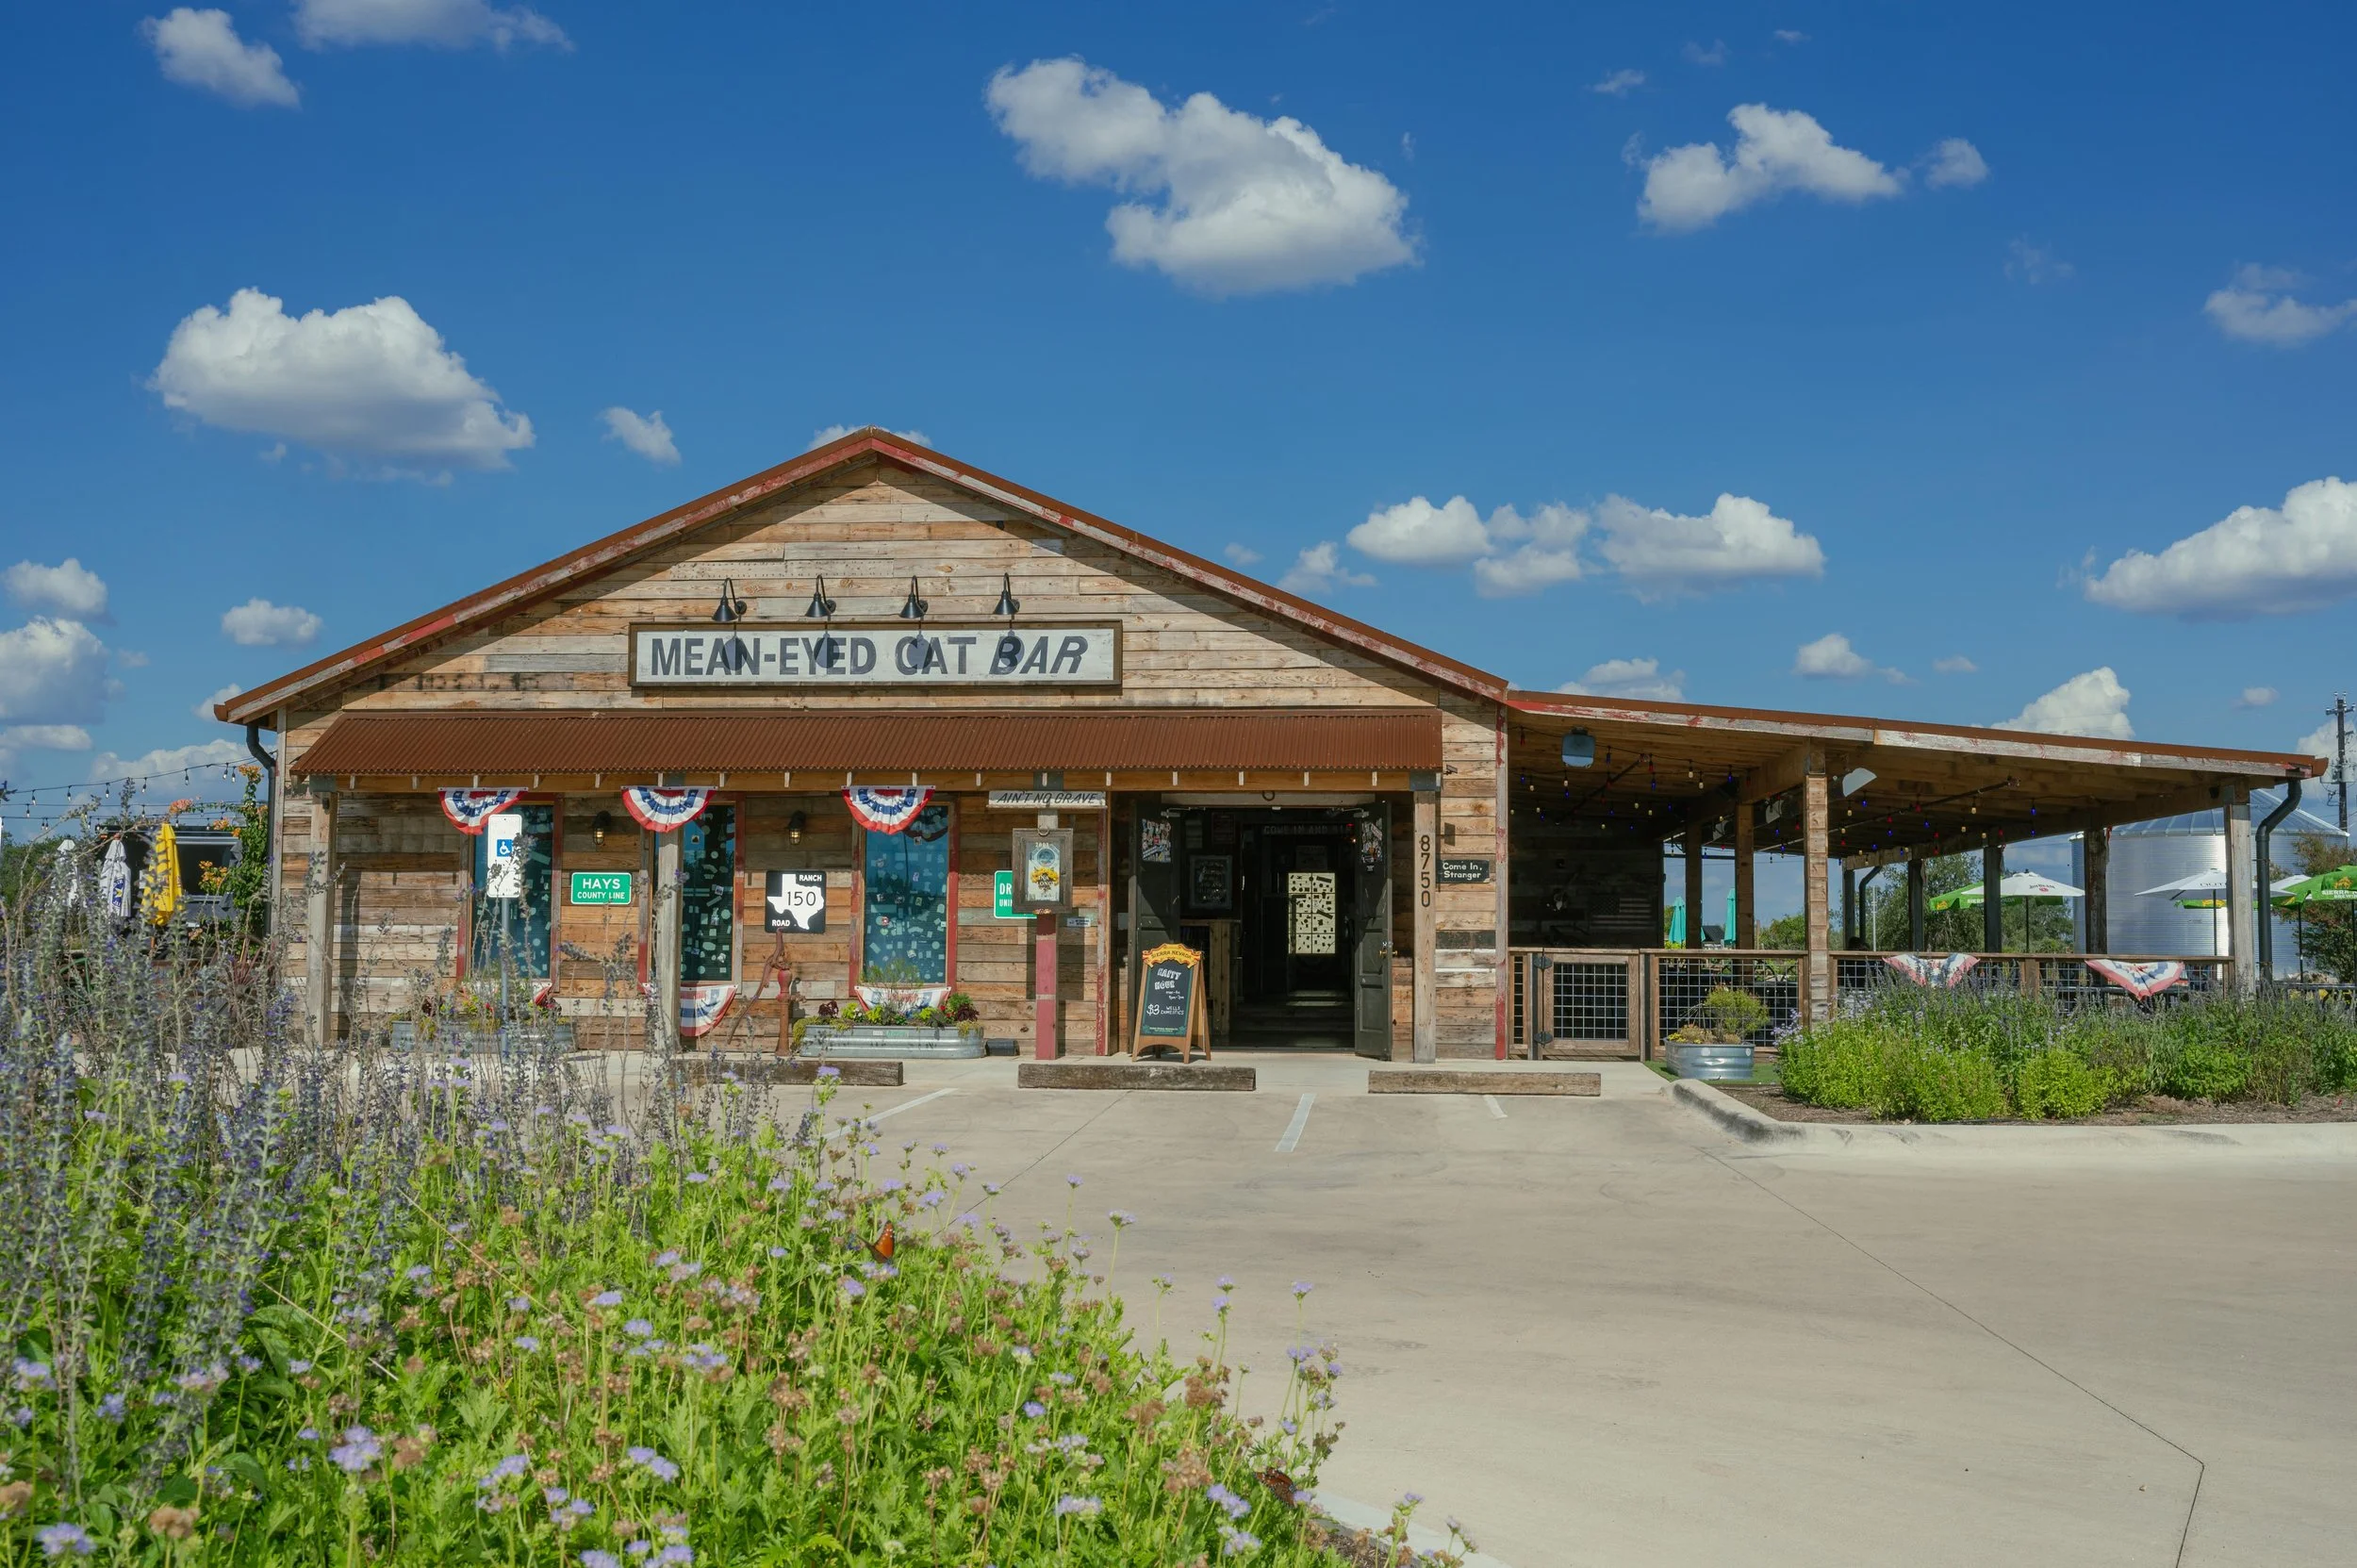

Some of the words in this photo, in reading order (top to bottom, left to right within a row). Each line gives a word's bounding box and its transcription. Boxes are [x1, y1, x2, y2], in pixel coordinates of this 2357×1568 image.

[651, 637, 877, 676] MEAN-EYED
[895, 635, 977, 675] CAT
[988, 635, 1089, 675] BAR
[997, 791, 1032, 803] AIN'T
[1033, 792, 1052, 803] NO
[1054, 792, 1098, 803] GRAVE
[1420, 834, 1431, 907] 8750
[1442, 862, 1467, 870] Come
[1443, 870, 1481, 881] Stranger
[582, 878, 620, 889] HAYS
[577, 891, 606, 900] COUNTY
[608, 891, 626, 900] LINE
[787, 891, 816, 906] 150
[1150, 949, 1170, 958] SIERRA
[1171, 949, 1192, 959] NEVADA
[1154, 980, 1175, 990] HOUR
[1146, 1003, 1160, 1016] $3
